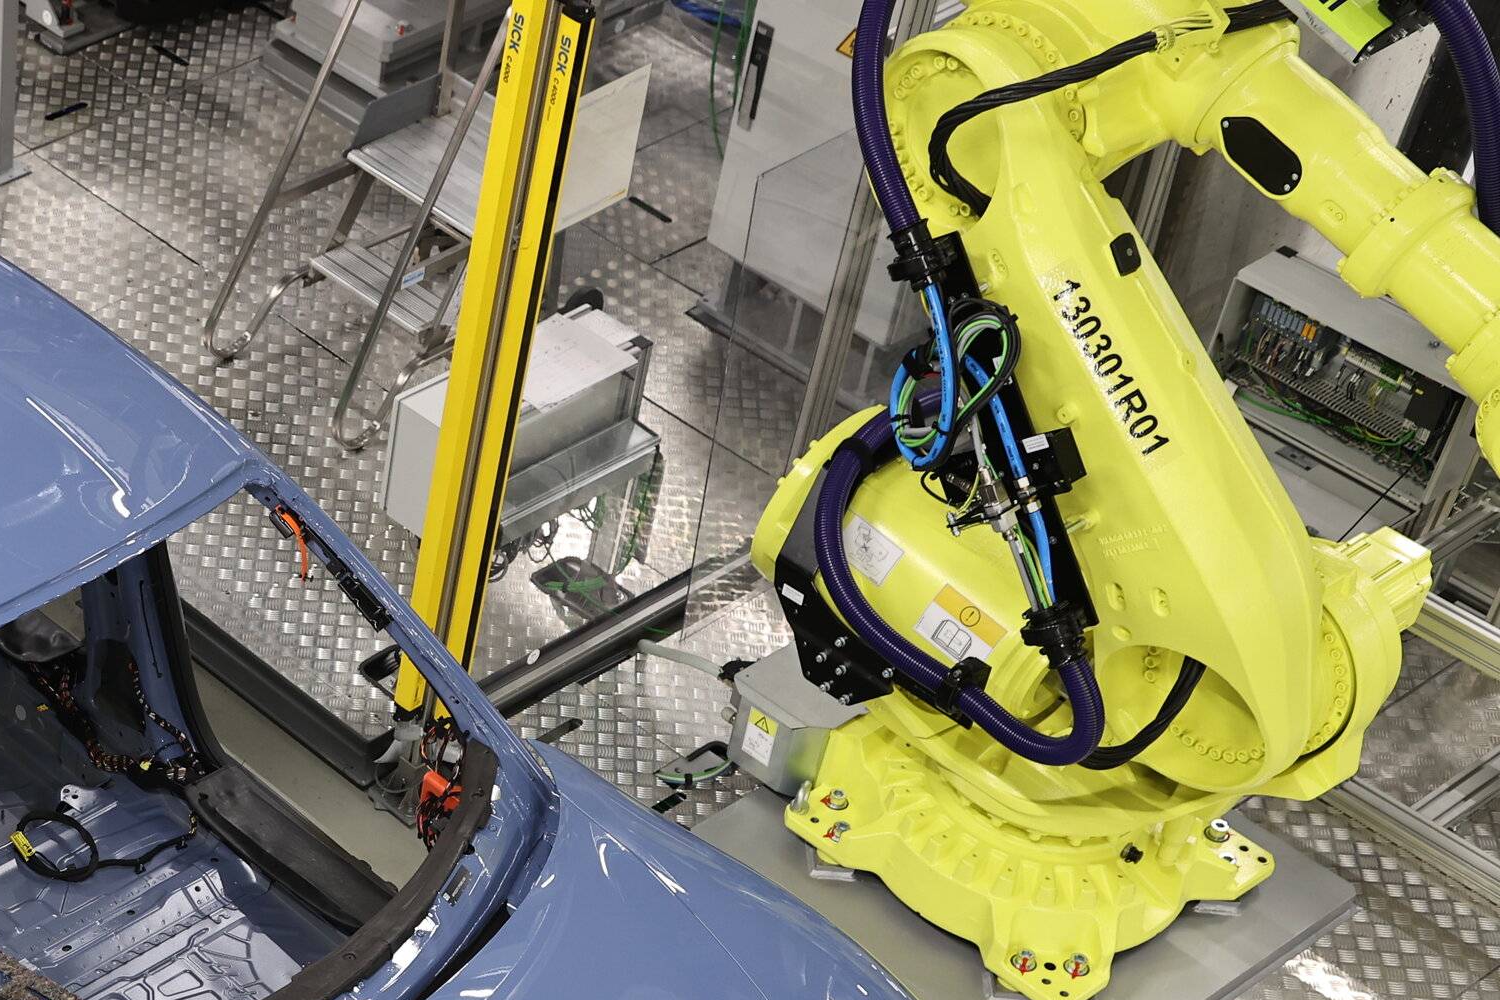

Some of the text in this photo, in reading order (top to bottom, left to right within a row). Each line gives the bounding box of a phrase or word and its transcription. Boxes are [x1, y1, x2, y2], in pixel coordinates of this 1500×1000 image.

[509, 13, 524, 54] SICK
[556, 35, 572, 77] SICK
[1053, 279, 1170, 457] 130301R01
